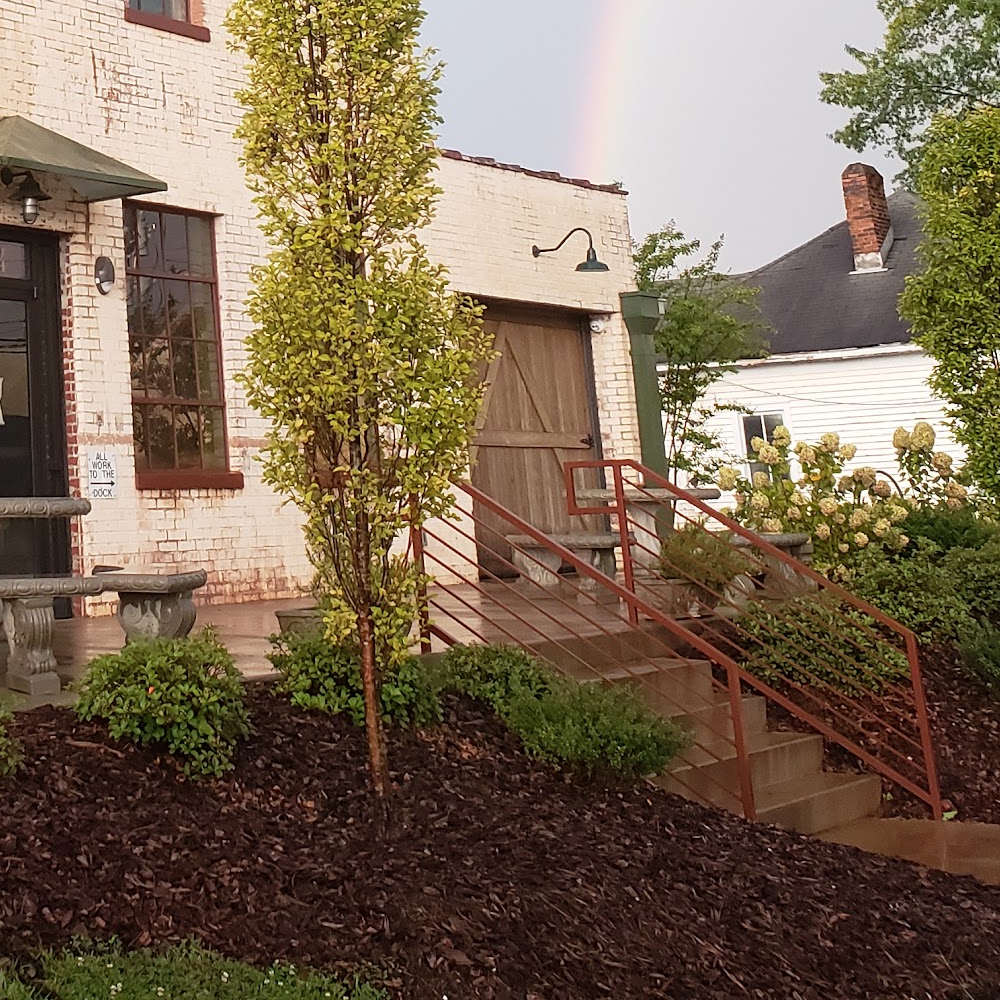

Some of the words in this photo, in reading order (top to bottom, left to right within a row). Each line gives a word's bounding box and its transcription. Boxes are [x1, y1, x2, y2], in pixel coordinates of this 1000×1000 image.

[96, 452, 108, 461] ALL
[92, 461, 112, 469] WORK
[89, 470, 97, 478] TO
[102, 470, 114, 478] THE
[93, 489, 112, 497] DOCK
